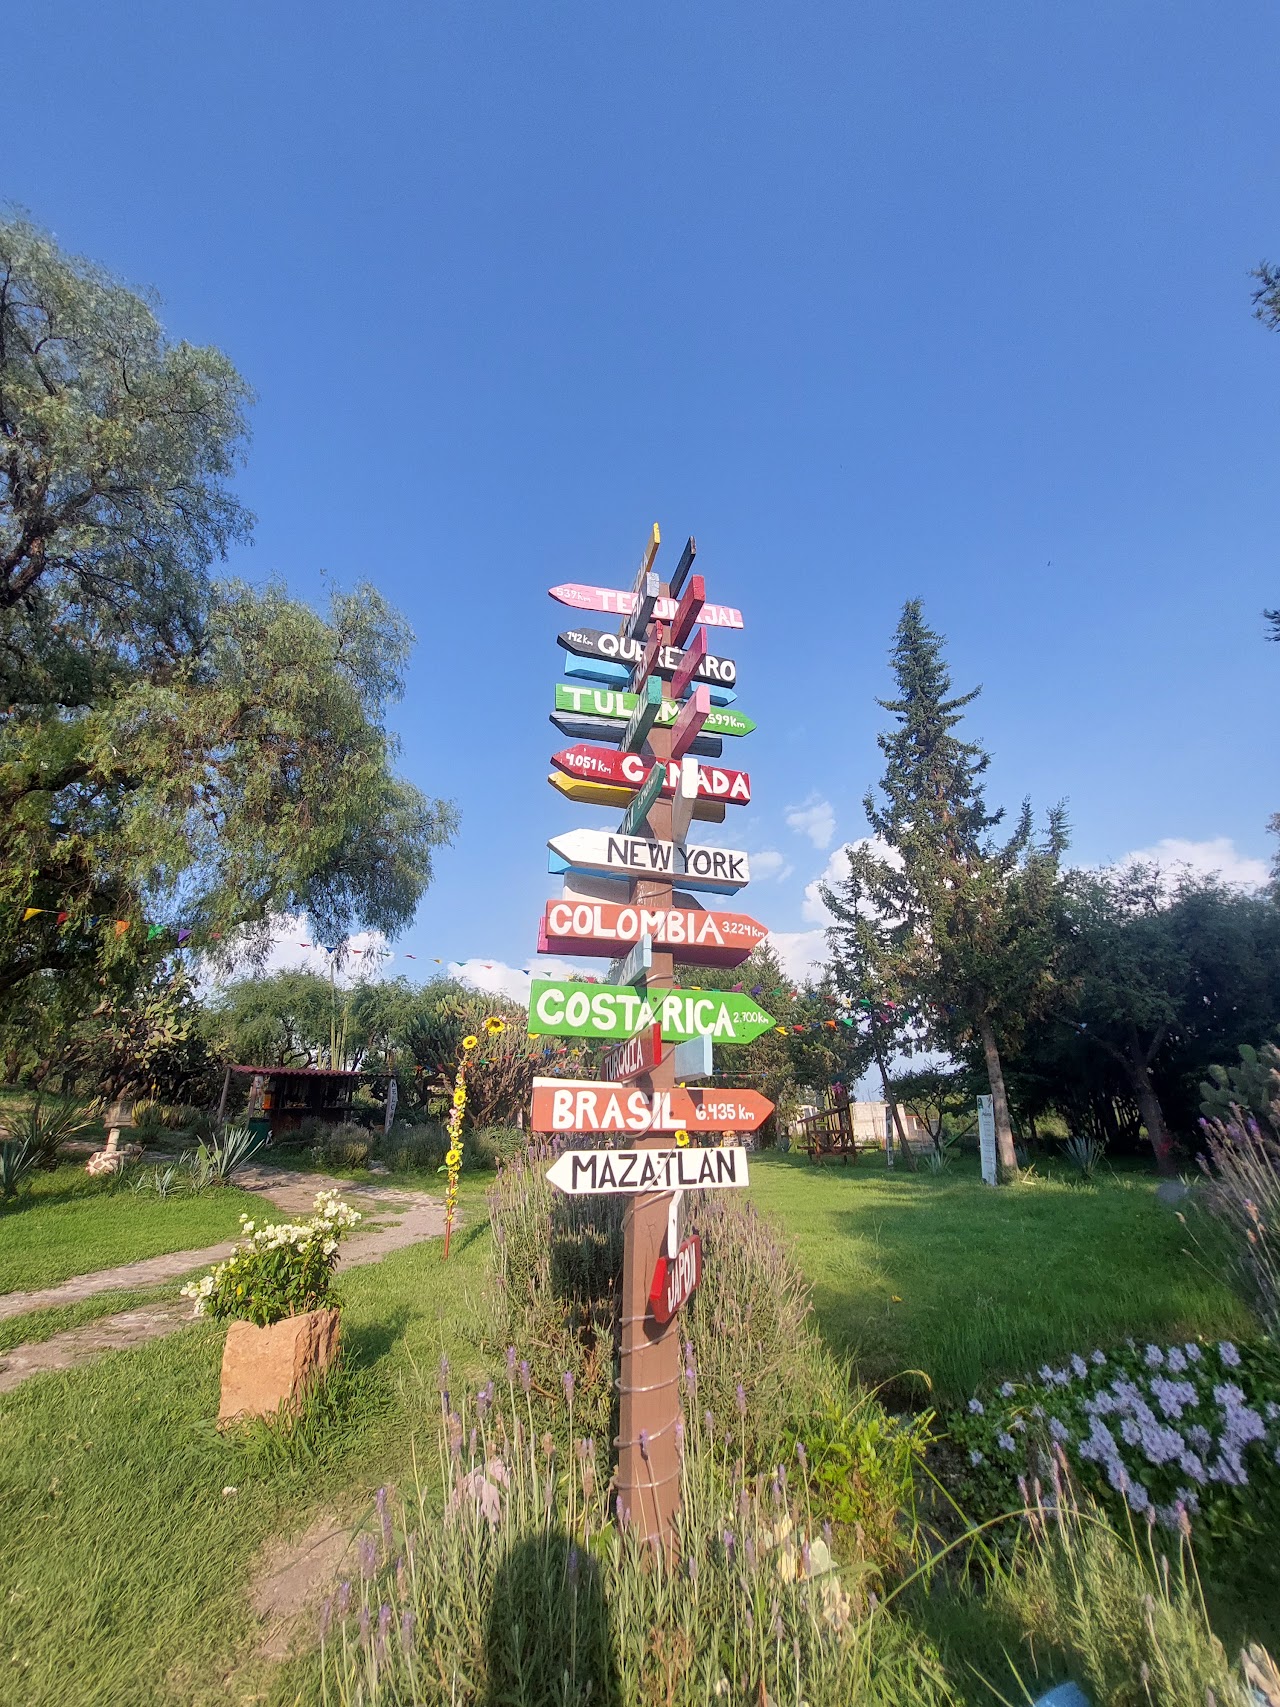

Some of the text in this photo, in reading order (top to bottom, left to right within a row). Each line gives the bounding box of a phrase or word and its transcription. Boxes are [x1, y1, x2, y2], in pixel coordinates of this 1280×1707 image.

[608, 838, 744, 879] NEW YORK
[549, 903, 724, 945] COLOMBIA
[537, 988, 655, 1031] COSTA
[662, 995, 735, 1038] RICA
[553, 1089, 686, 1130] BRASIL
